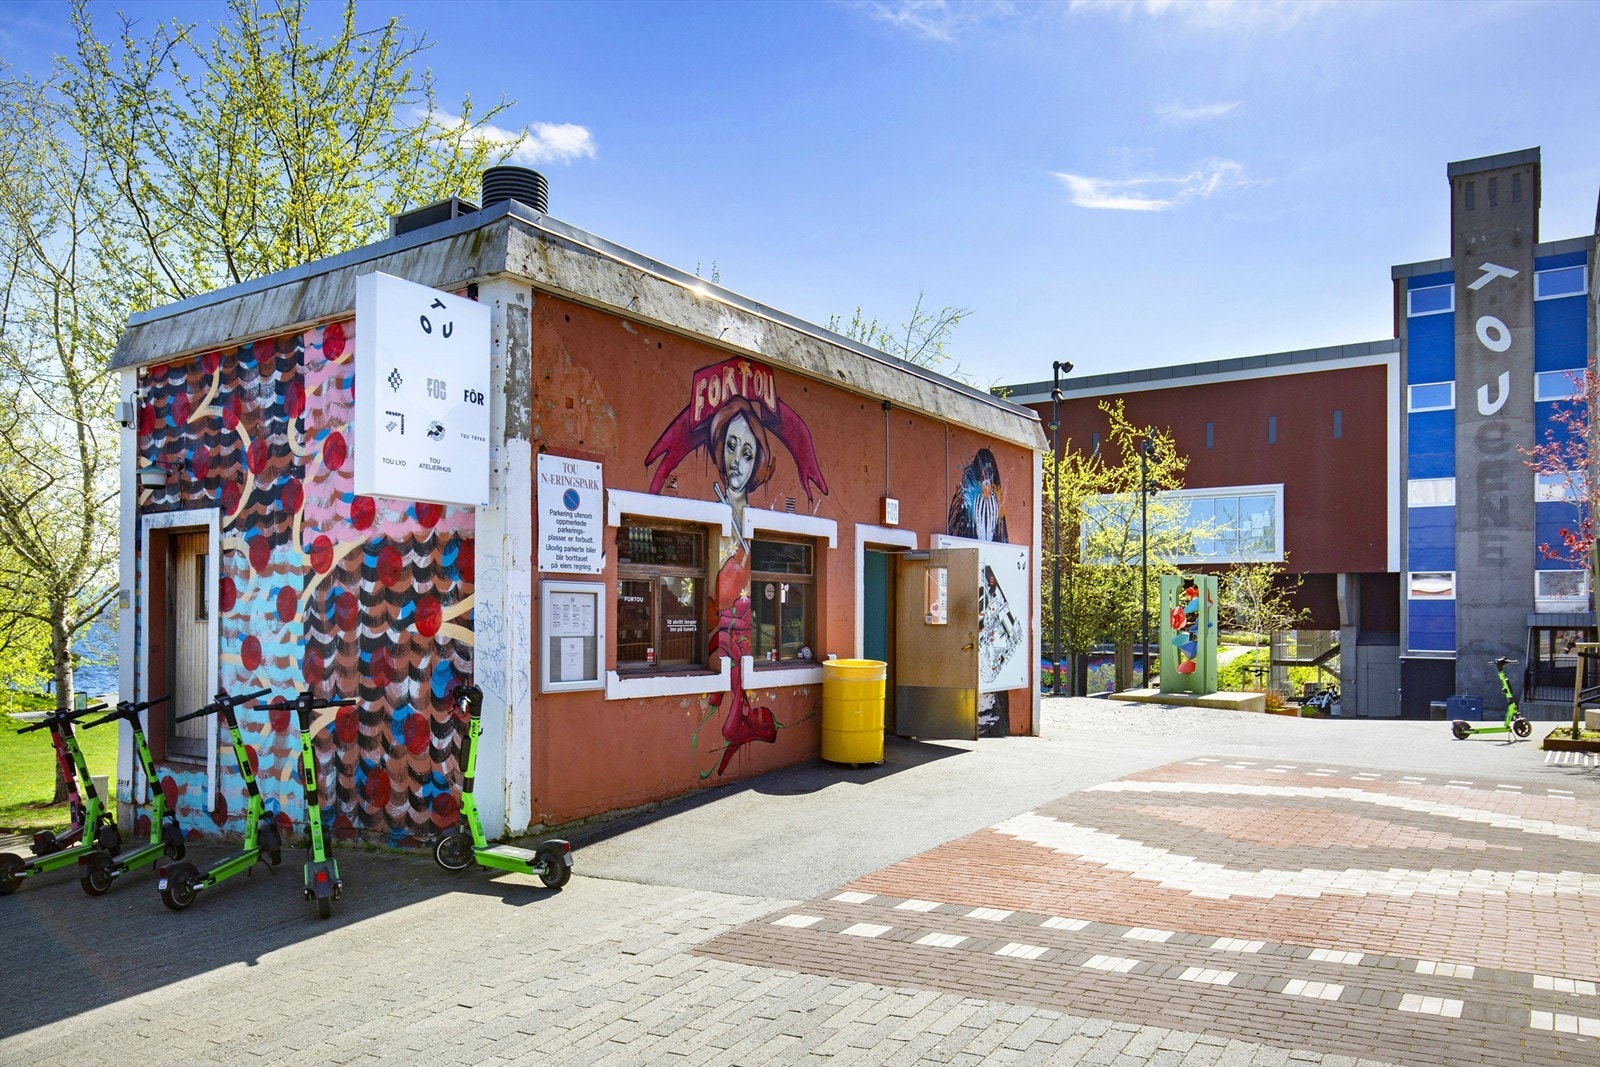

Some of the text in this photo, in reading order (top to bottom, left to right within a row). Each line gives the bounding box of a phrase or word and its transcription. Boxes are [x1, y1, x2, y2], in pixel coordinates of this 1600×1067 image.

[420, 298, 453, 339] TOU
[1467, 262, 1519, 416] TOU
[382, 457, 407, 467] TOU LYD
[418, 463, 452, 473] ATELIERHUS
[562, 463, 579, 474] TOU
[541, 473, 599, 490] NÆRINGSPARK
[549, 509, 573, 519] Parkering
[556, 519, 587, 527] oppmerkede
[557, 527, 586, 535] parkerings-
[545, 544, 563, 553] Ulovlig
